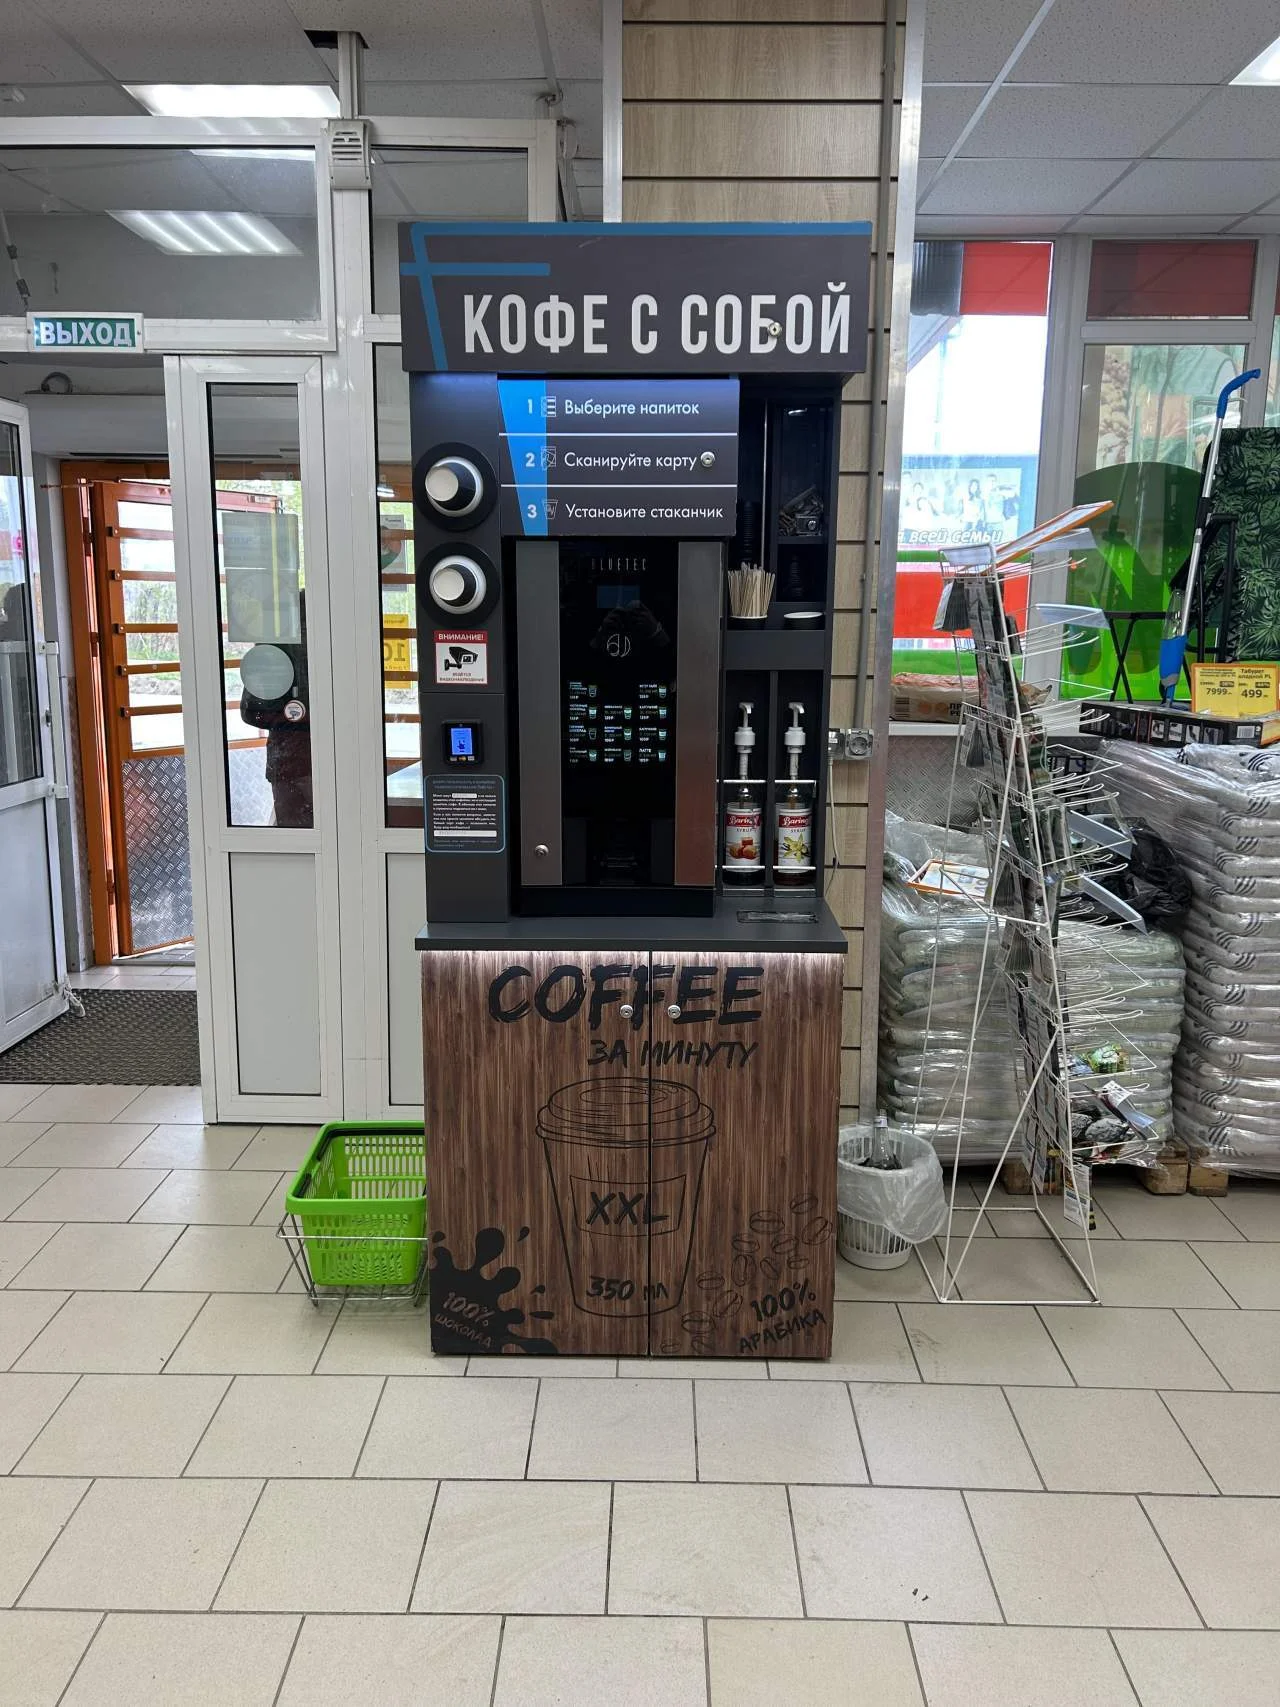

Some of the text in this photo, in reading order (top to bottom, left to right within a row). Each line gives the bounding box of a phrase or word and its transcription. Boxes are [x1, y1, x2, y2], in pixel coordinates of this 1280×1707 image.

[463, 281, 851, 355] КОФЕ С СОБОЙ
[39, 321, 133, 347] ВЫХОД
[527, 398, 700, 419] 1 Выберите напиток
[525, 450, 697, 471] 2 Сканируйте карту
[527, 504, 724, 519] 3 Установите стаканчик
[438, 633, 484, 641] ВНИМАНИЕ!
[1241, 689, 1263, 698] 499
[488, 964, 765, 1030] COFFEE
[587, 1040, 760, 1069] ЗА МИНУТУ
[586, 1192, 670, 1225] XXL
[586, 1276, 635, 1301] 350
[751, 1277, 817, 1322] 100%
[443, 1291, 496, 1327] 100%
[738, 1308, 828, 1354] АРАБИКА
